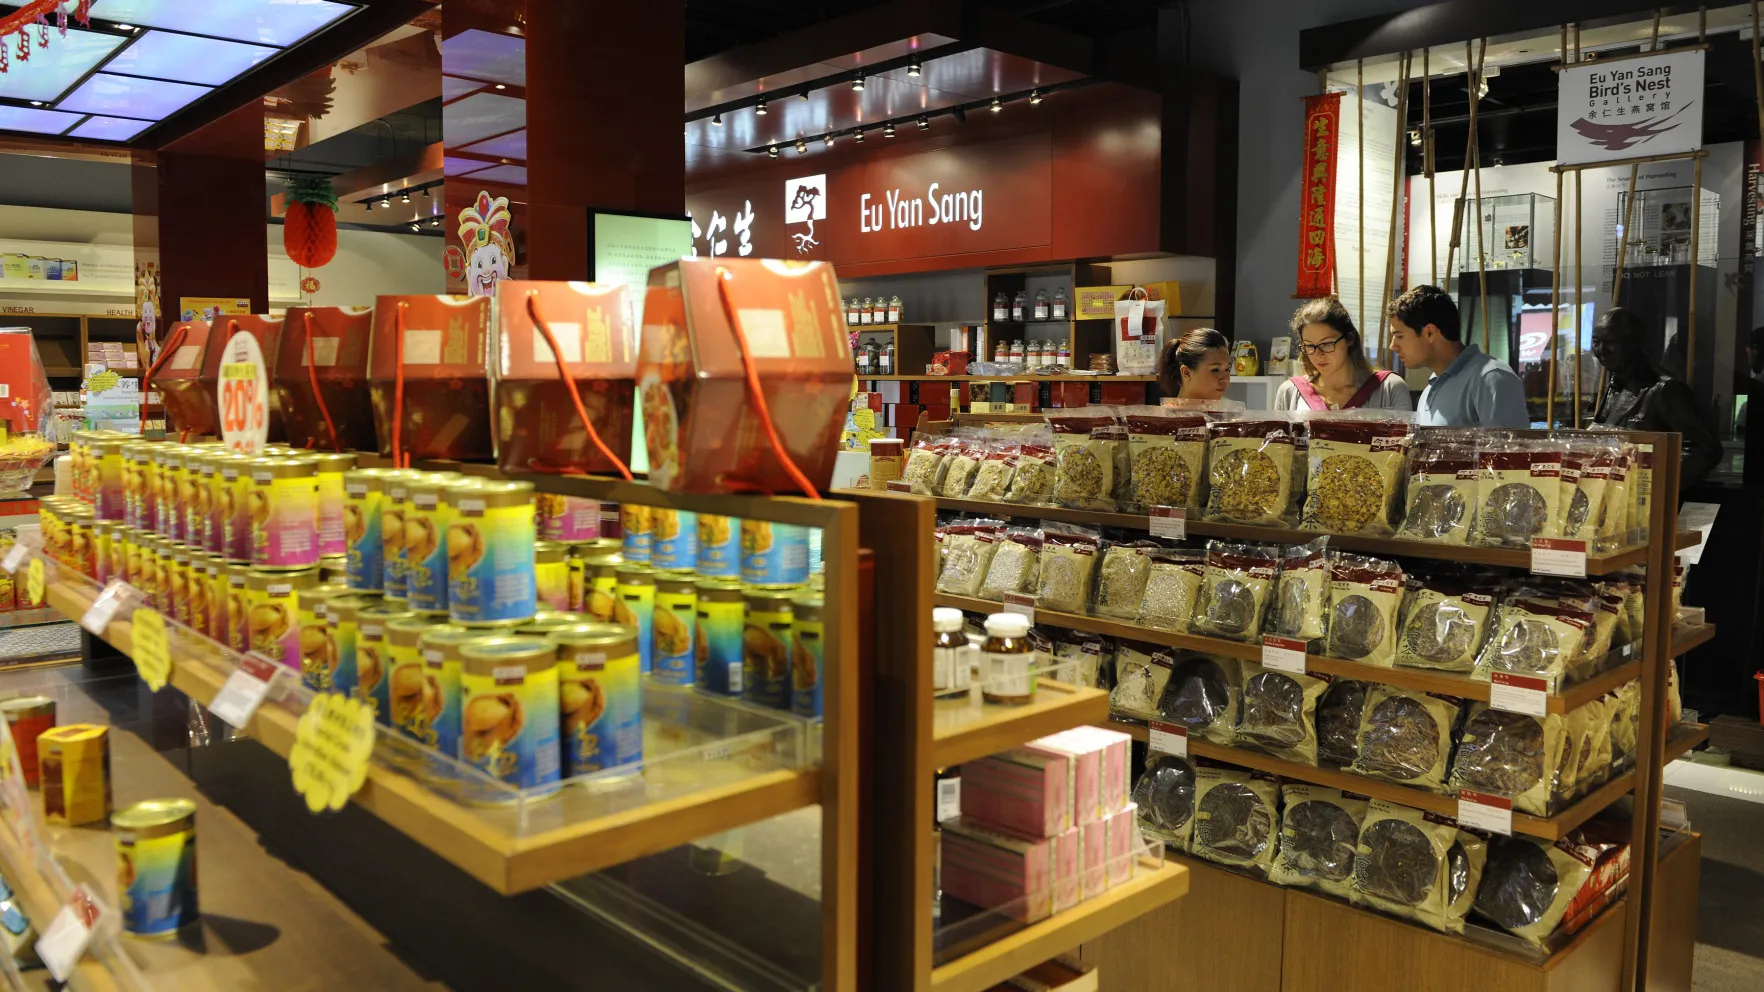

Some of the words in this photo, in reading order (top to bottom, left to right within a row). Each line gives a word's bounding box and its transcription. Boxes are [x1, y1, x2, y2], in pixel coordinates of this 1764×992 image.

[1590, 73, 1607, 85] Eu
[1610, 70, 1633, 81] Yan
[1637, 65, 1671, 78] Sang
[1589, 82, 1631, 99] Bird's
[1635, 77, 1671, 93] Nest
[1589, 91, 1671, 107] Gallery
[1588, 101, 1671, 119] 余仁生燕窝馆
[1646, 172, 1678, 180] Harvesting
[1743, 163, 1761, 226] Harvesting
[861, 193, 884, 233] Eu
[886, 188, 923, 230] Yan
[928, 182, 983, 231] Sang
[2, 306, 34, 314] VINEGAR
[223, 379, 264, 432] 20%
